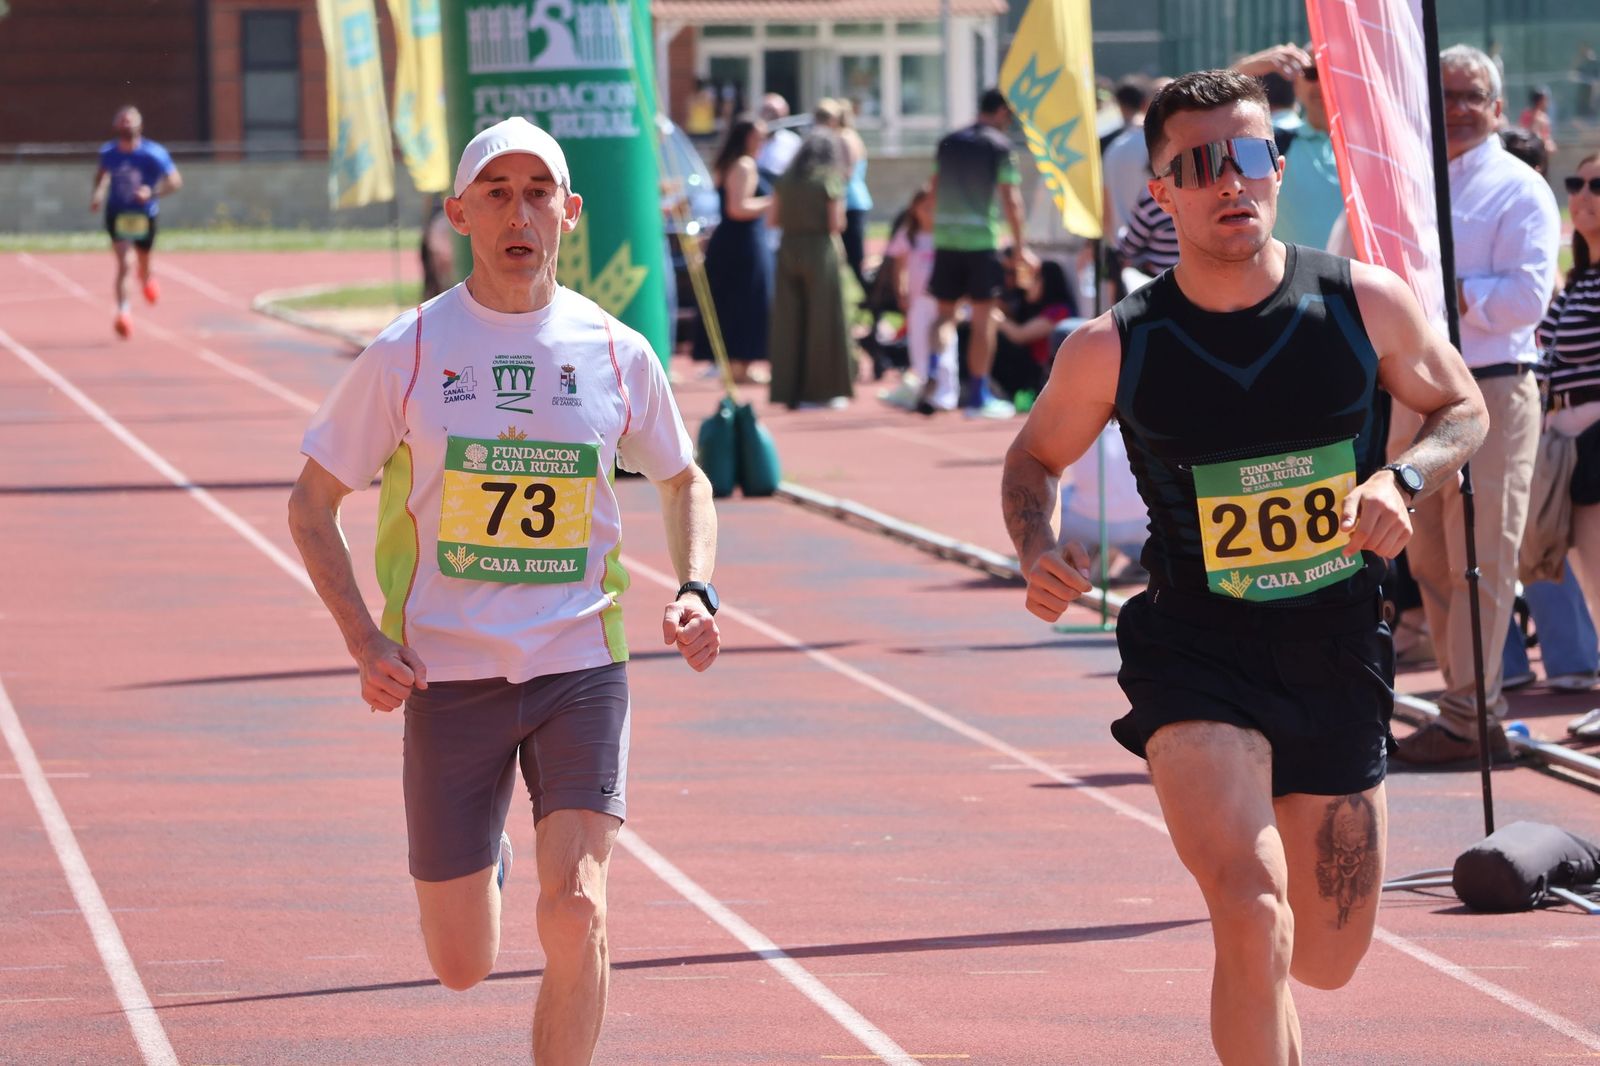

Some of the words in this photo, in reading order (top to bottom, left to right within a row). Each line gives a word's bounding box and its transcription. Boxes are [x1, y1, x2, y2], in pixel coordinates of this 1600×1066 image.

[550, 110, 640, 138] RURAL
[443, 388, 465, 396] CANAL
[444, 393, 477, 404] ZAMORA
[492, 446, 581, 463] FUNDACION
[491, 460, 526, 473] CAJA
[529, 462, 578, 475] RURAL
[1241, 474, 1271, 487] CAJA
[1273, 466, 1315, 482] RURAL
[1242, 485, 1252, 493] DE
[1254, 481, 1284, 492] ZAMORA
[481, 482, 556, 539] 73
[1212, 487, 1339, 559] 268
[479, 557, 521, 573] CAJA
[524, 558, 578, 574] RURAL
[1256, 574, 1301, 590] CAJA
[1304, 555, 1356, 584] RURAL
